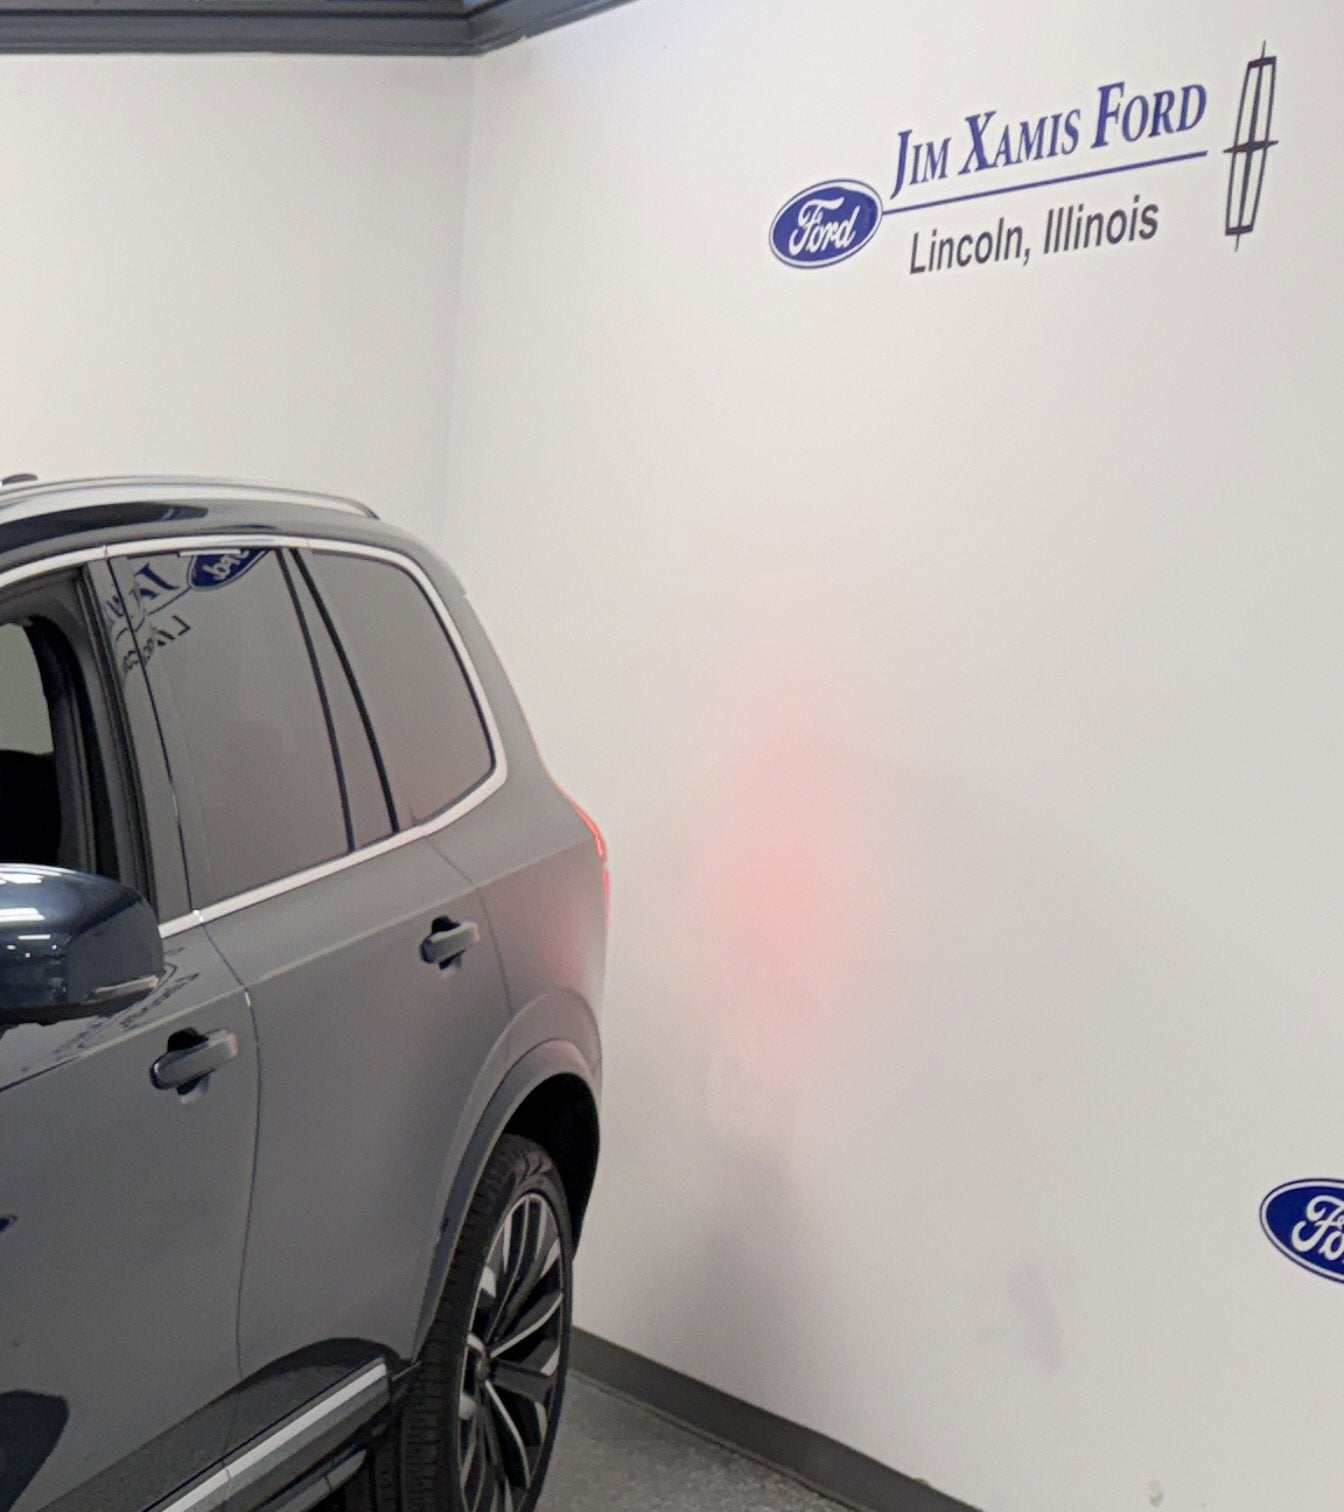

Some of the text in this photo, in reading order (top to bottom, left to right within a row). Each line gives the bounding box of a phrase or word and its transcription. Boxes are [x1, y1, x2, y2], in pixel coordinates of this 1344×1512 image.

[890, 81, 1207, 199] JIM XAMIS FORD
[788, 196, 860, 257] Ford
[910, 195, 1159, 275] Lincoln, Illinois
